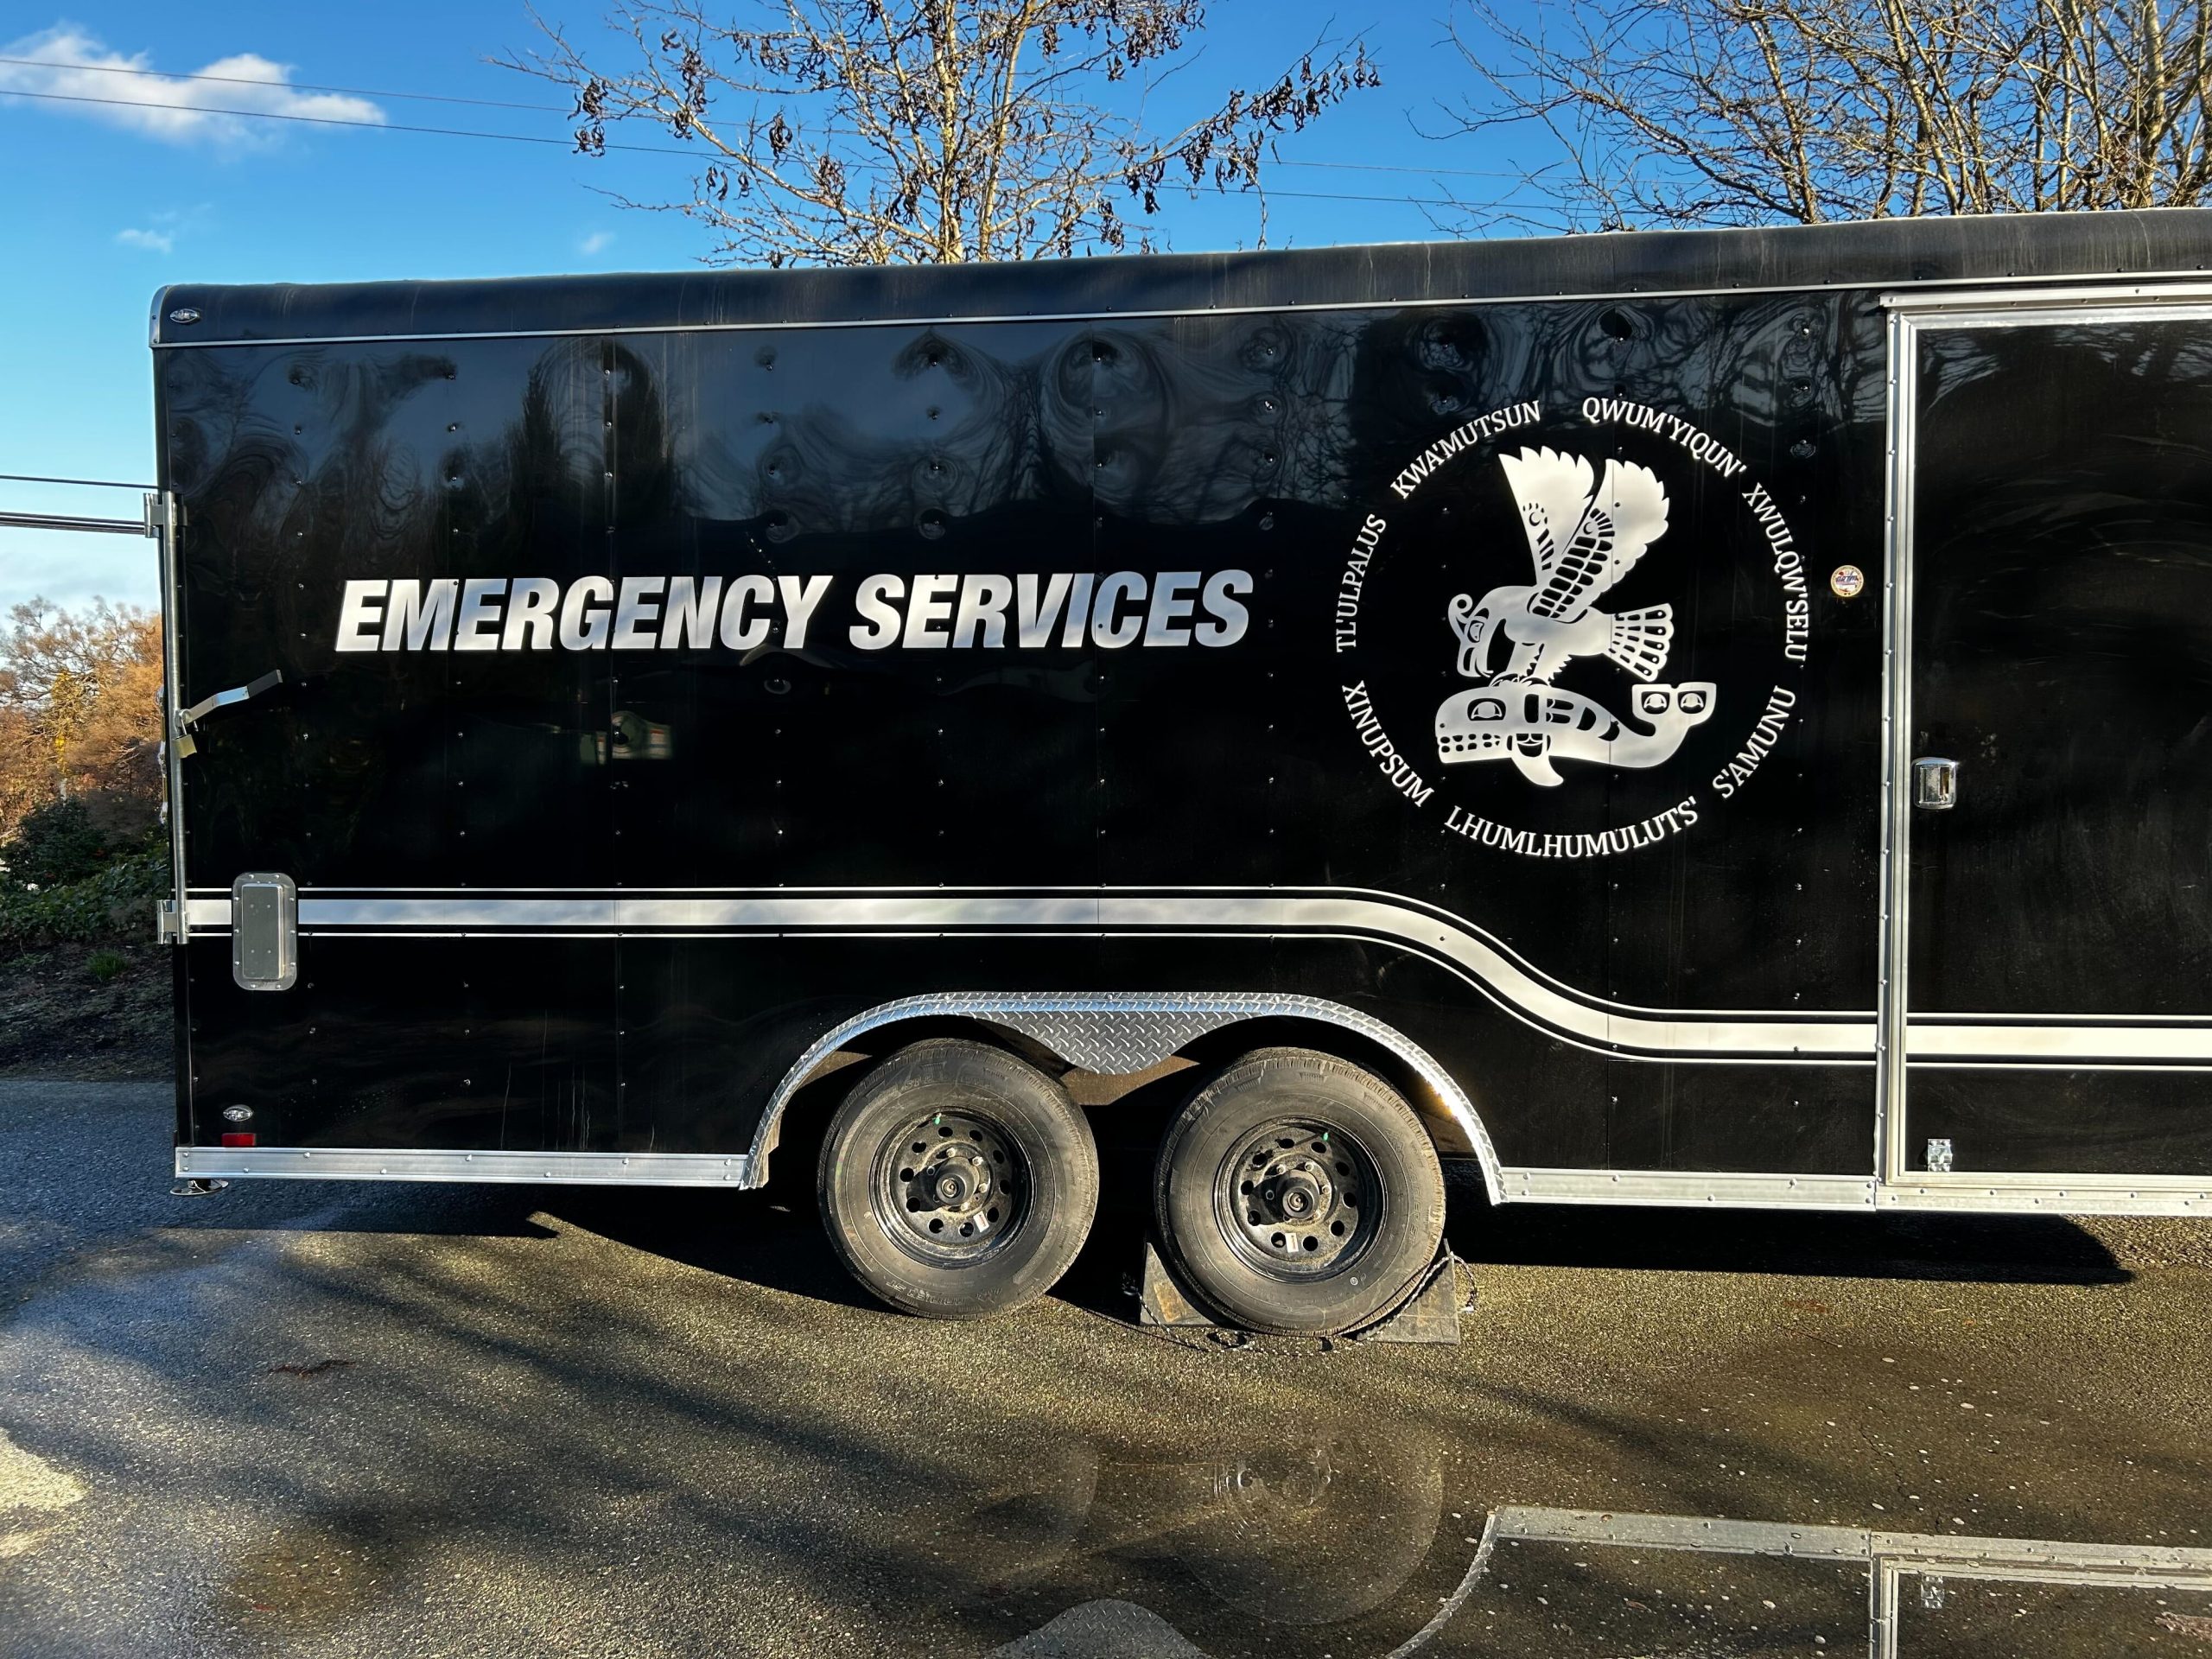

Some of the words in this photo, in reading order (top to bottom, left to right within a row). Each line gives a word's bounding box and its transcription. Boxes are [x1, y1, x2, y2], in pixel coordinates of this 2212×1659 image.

[1389, 400, 1540, 499] KWA'MUTSUN
[1582, 397, 1747, 478] QWUM'YIQUN'
[334, 575, 834, 652] EMERGENCY
[849, 569, 1254, 651] SERVICES
[1336, 513, 1387, 652] TL'ULPALUS
[1742, 482, 1808, 661] XWULQW'SELU
[1341, 680, 1435, 808] XINUPSUM
[1711, 683, 1796, 799] S'AMUNU
[1444, 795, 1698, 858] LHUMLHUMULUTS'
